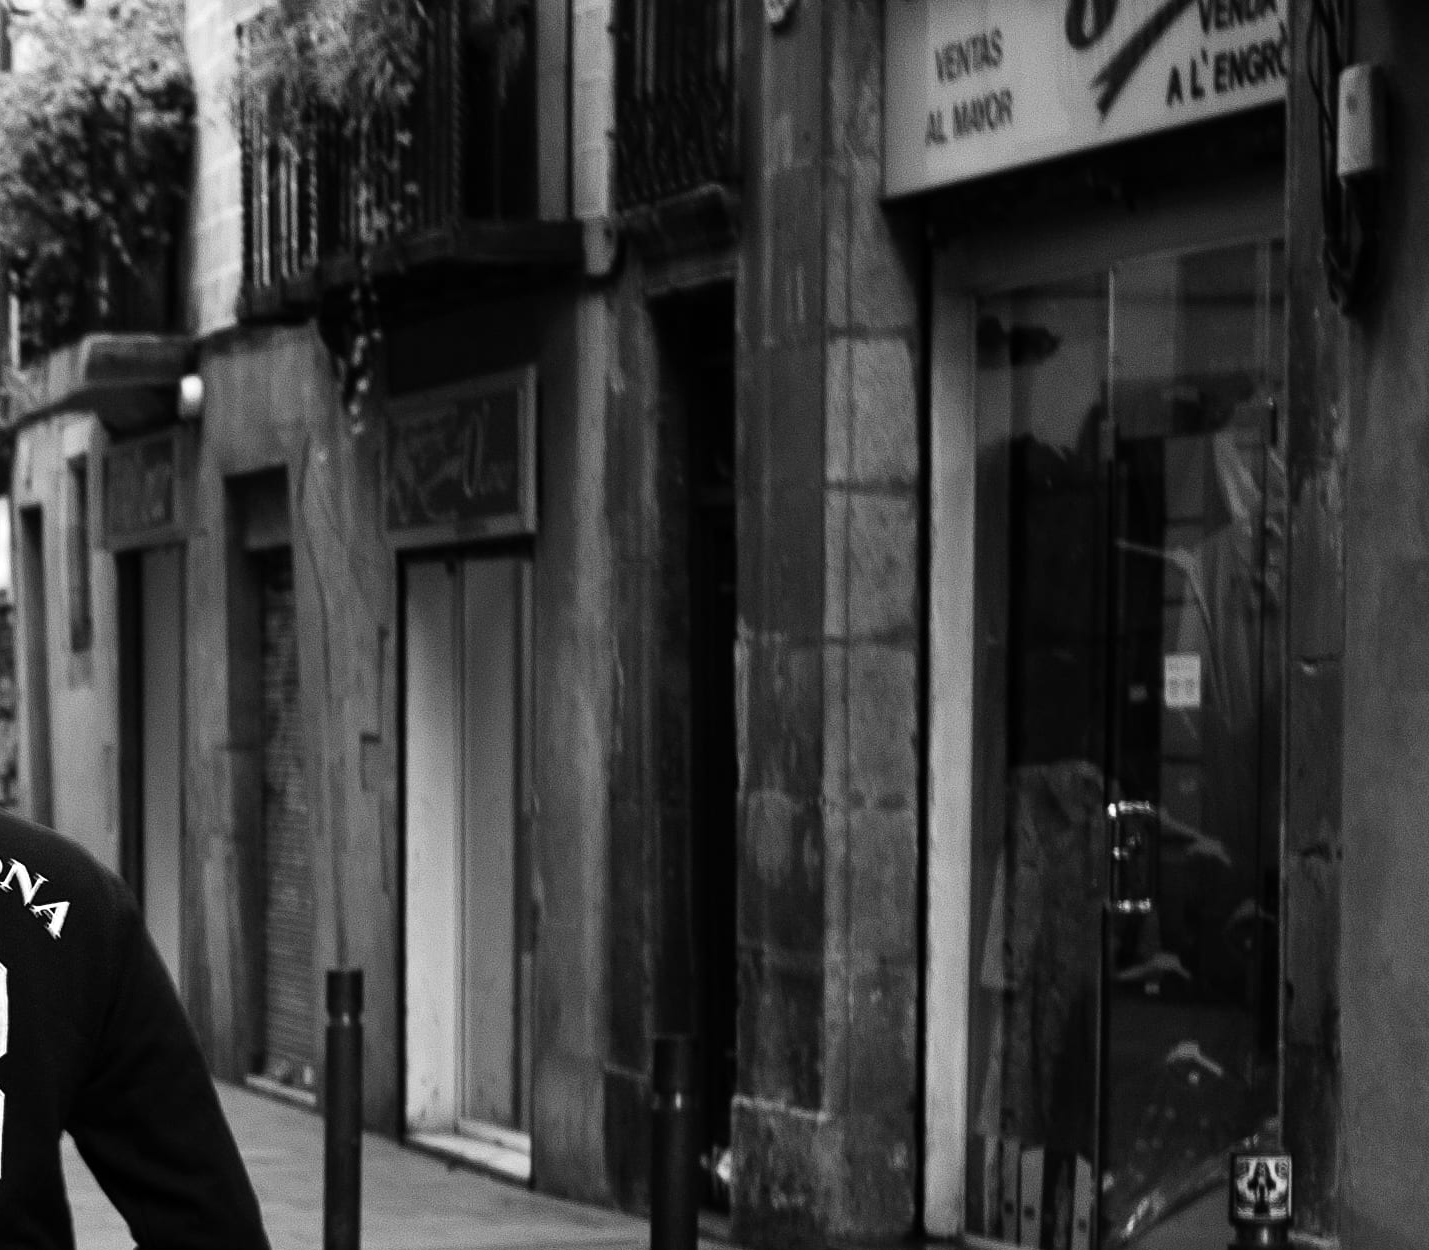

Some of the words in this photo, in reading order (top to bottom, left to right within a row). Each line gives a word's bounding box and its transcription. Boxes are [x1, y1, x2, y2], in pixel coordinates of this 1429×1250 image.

[935, 28, 1003, 82] VENTAS
[1166, 66, 1184, 107] A
[925, 111, 948, 146] AL
[952, 88, 1013, 139] MAYOR
